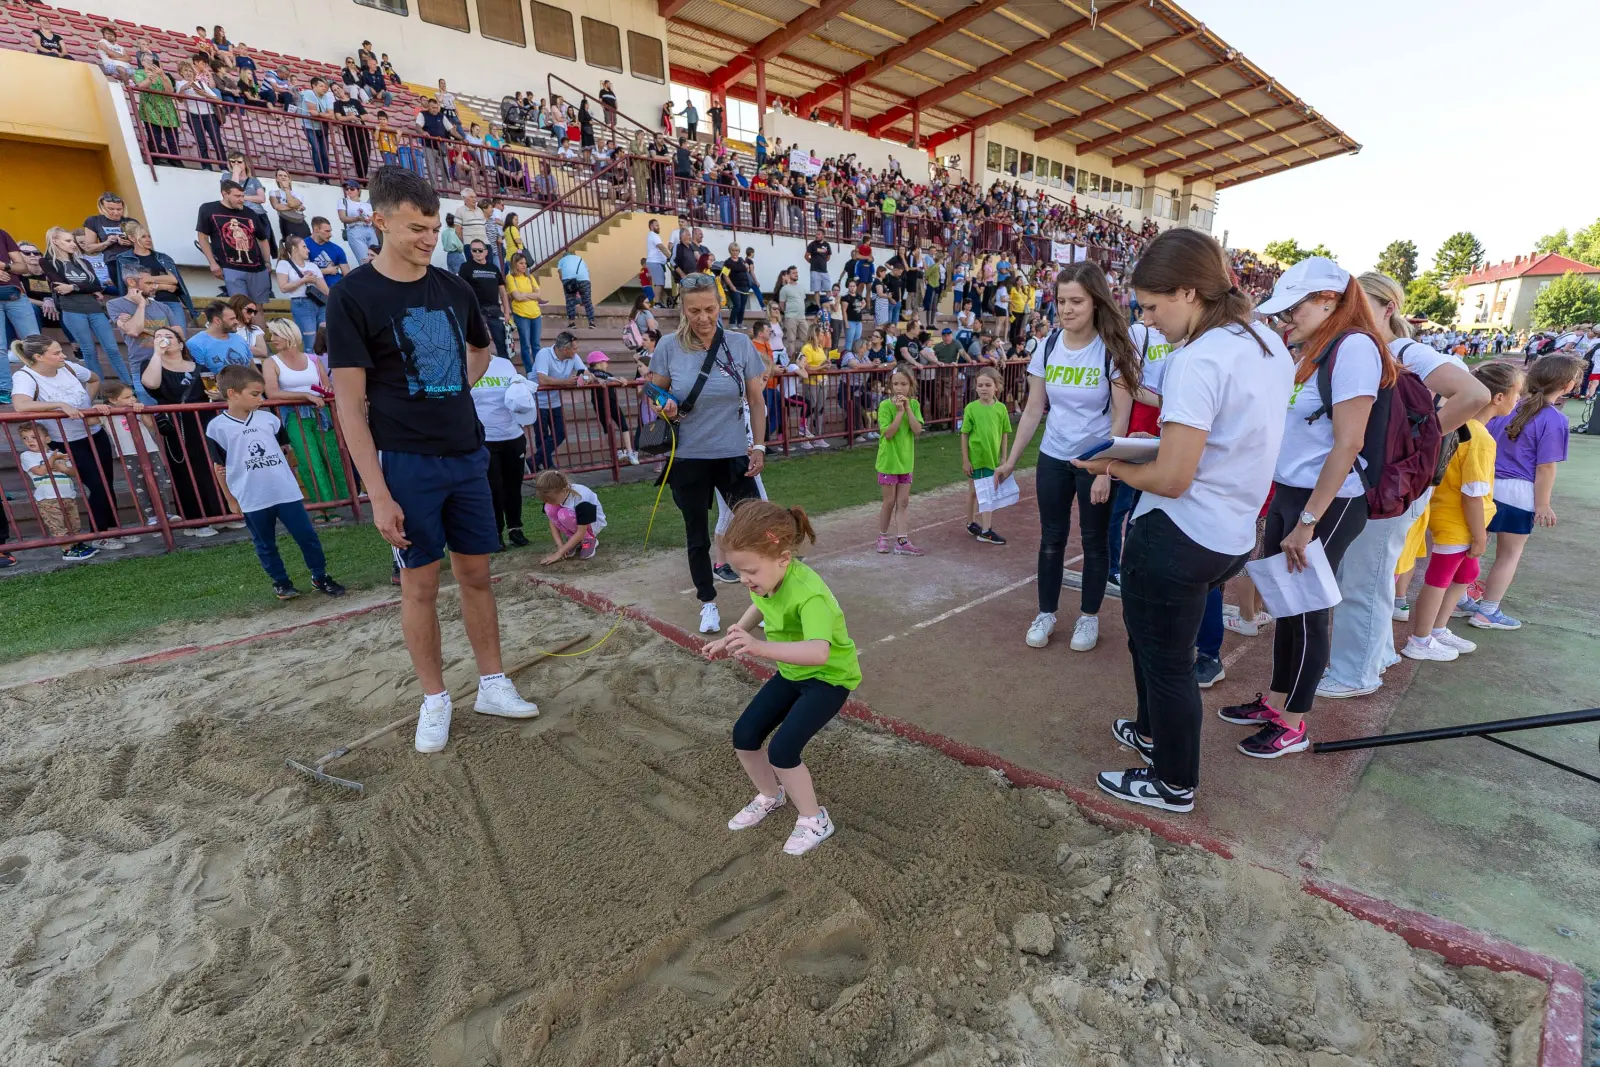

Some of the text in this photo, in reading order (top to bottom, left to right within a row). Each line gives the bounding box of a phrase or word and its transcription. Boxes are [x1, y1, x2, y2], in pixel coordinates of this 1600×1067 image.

[1046, 364, 1101, 385] OFDV 20
[1085, 376, 1100, 387] 24
[424, 385, 462, 393] JACK&JON
[246, 458, 284, 472] PANDA
